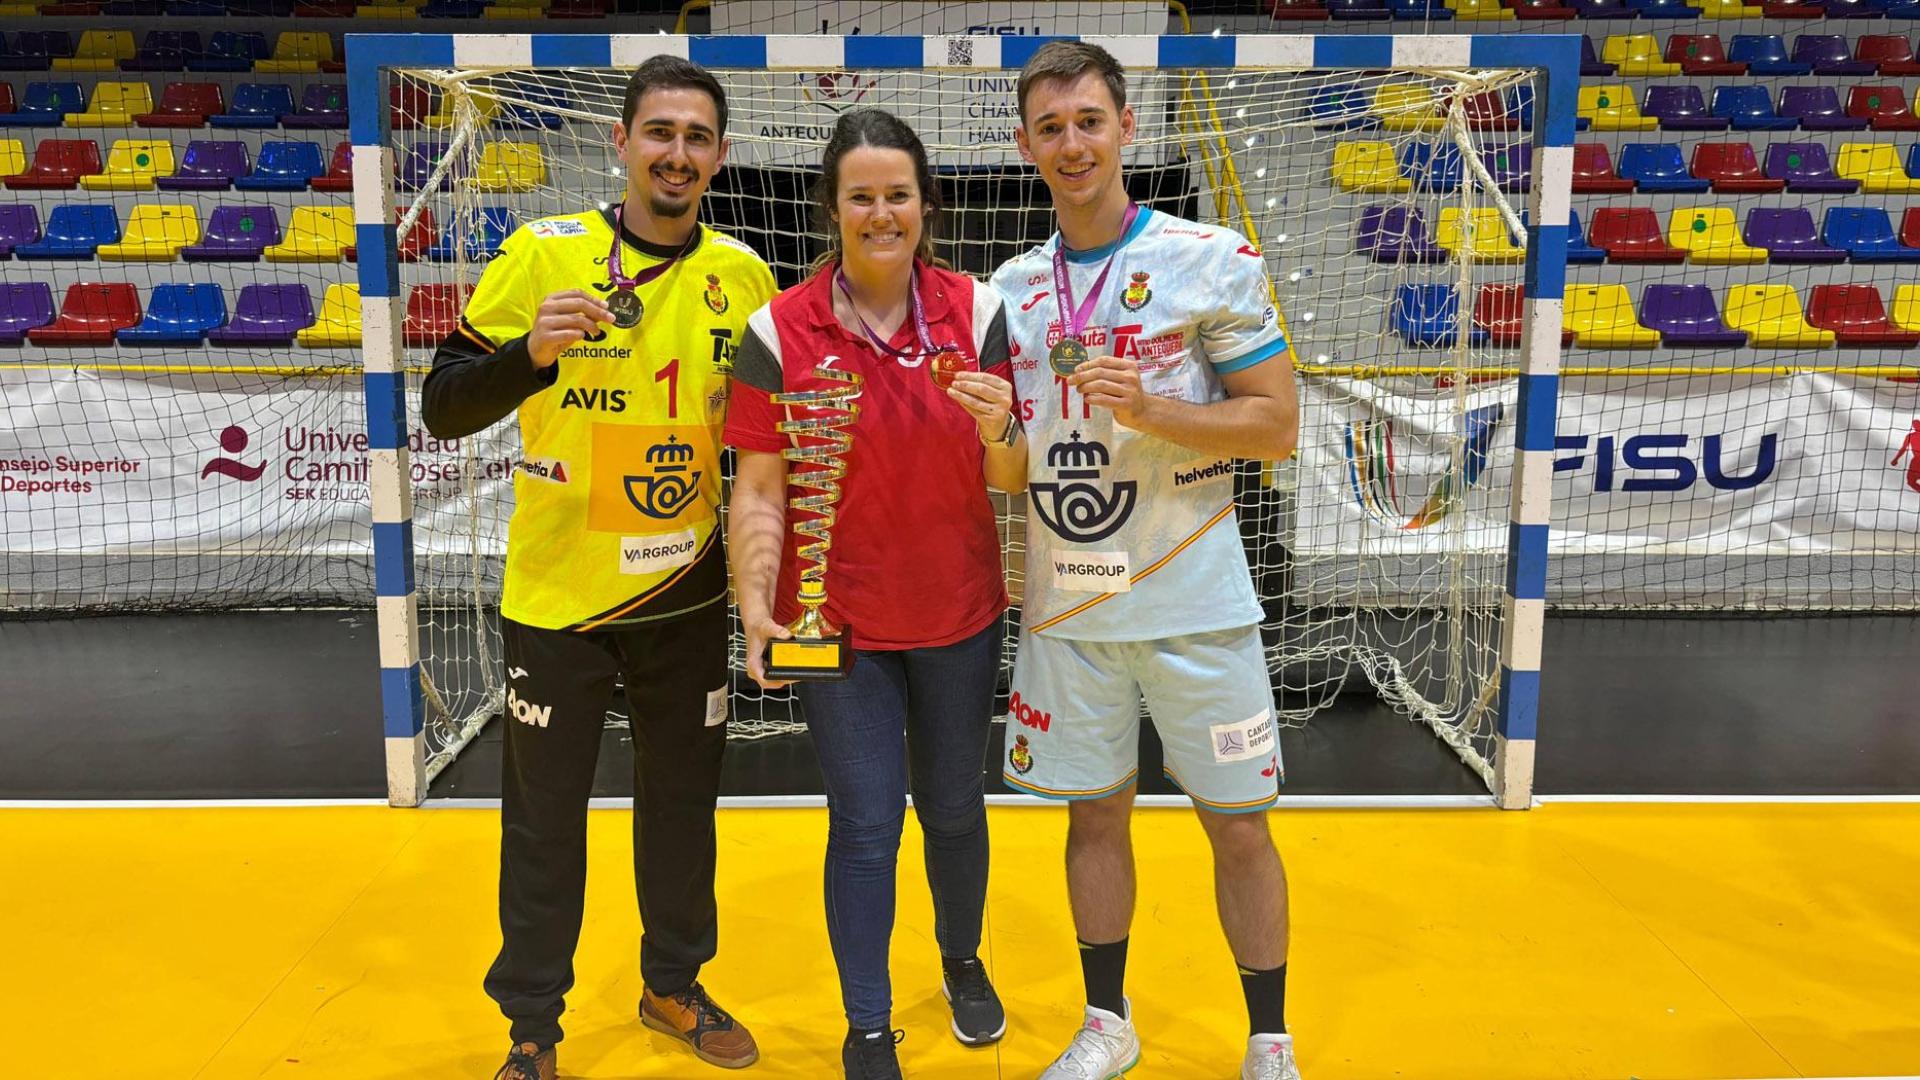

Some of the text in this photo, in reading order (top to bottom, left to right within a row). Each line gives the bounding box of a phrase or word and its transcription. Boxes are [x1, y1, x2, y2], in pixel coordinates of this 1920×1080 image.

[761, 126, 831, 140] ANTEQU
[655, 358, 679, 418] 1
[285, 427, 460, 453] Univedad
[0, 455, 140, 476] nsejo Superior
[285, 456, 370, 482] Camil
[1553, 433, 1778, 492] FISU
[1, 475, 92, 496] Deportes
[286, 488, 317, 500] SEK
[319, 488, 370, 501] EDUCA
[623, 540, 695, 563] VARGROUP
[1054, 561, 1126, 578] VARGROUP
[507, 687, 553, 728] AON
[1009, 691, 1051, 732] AON
